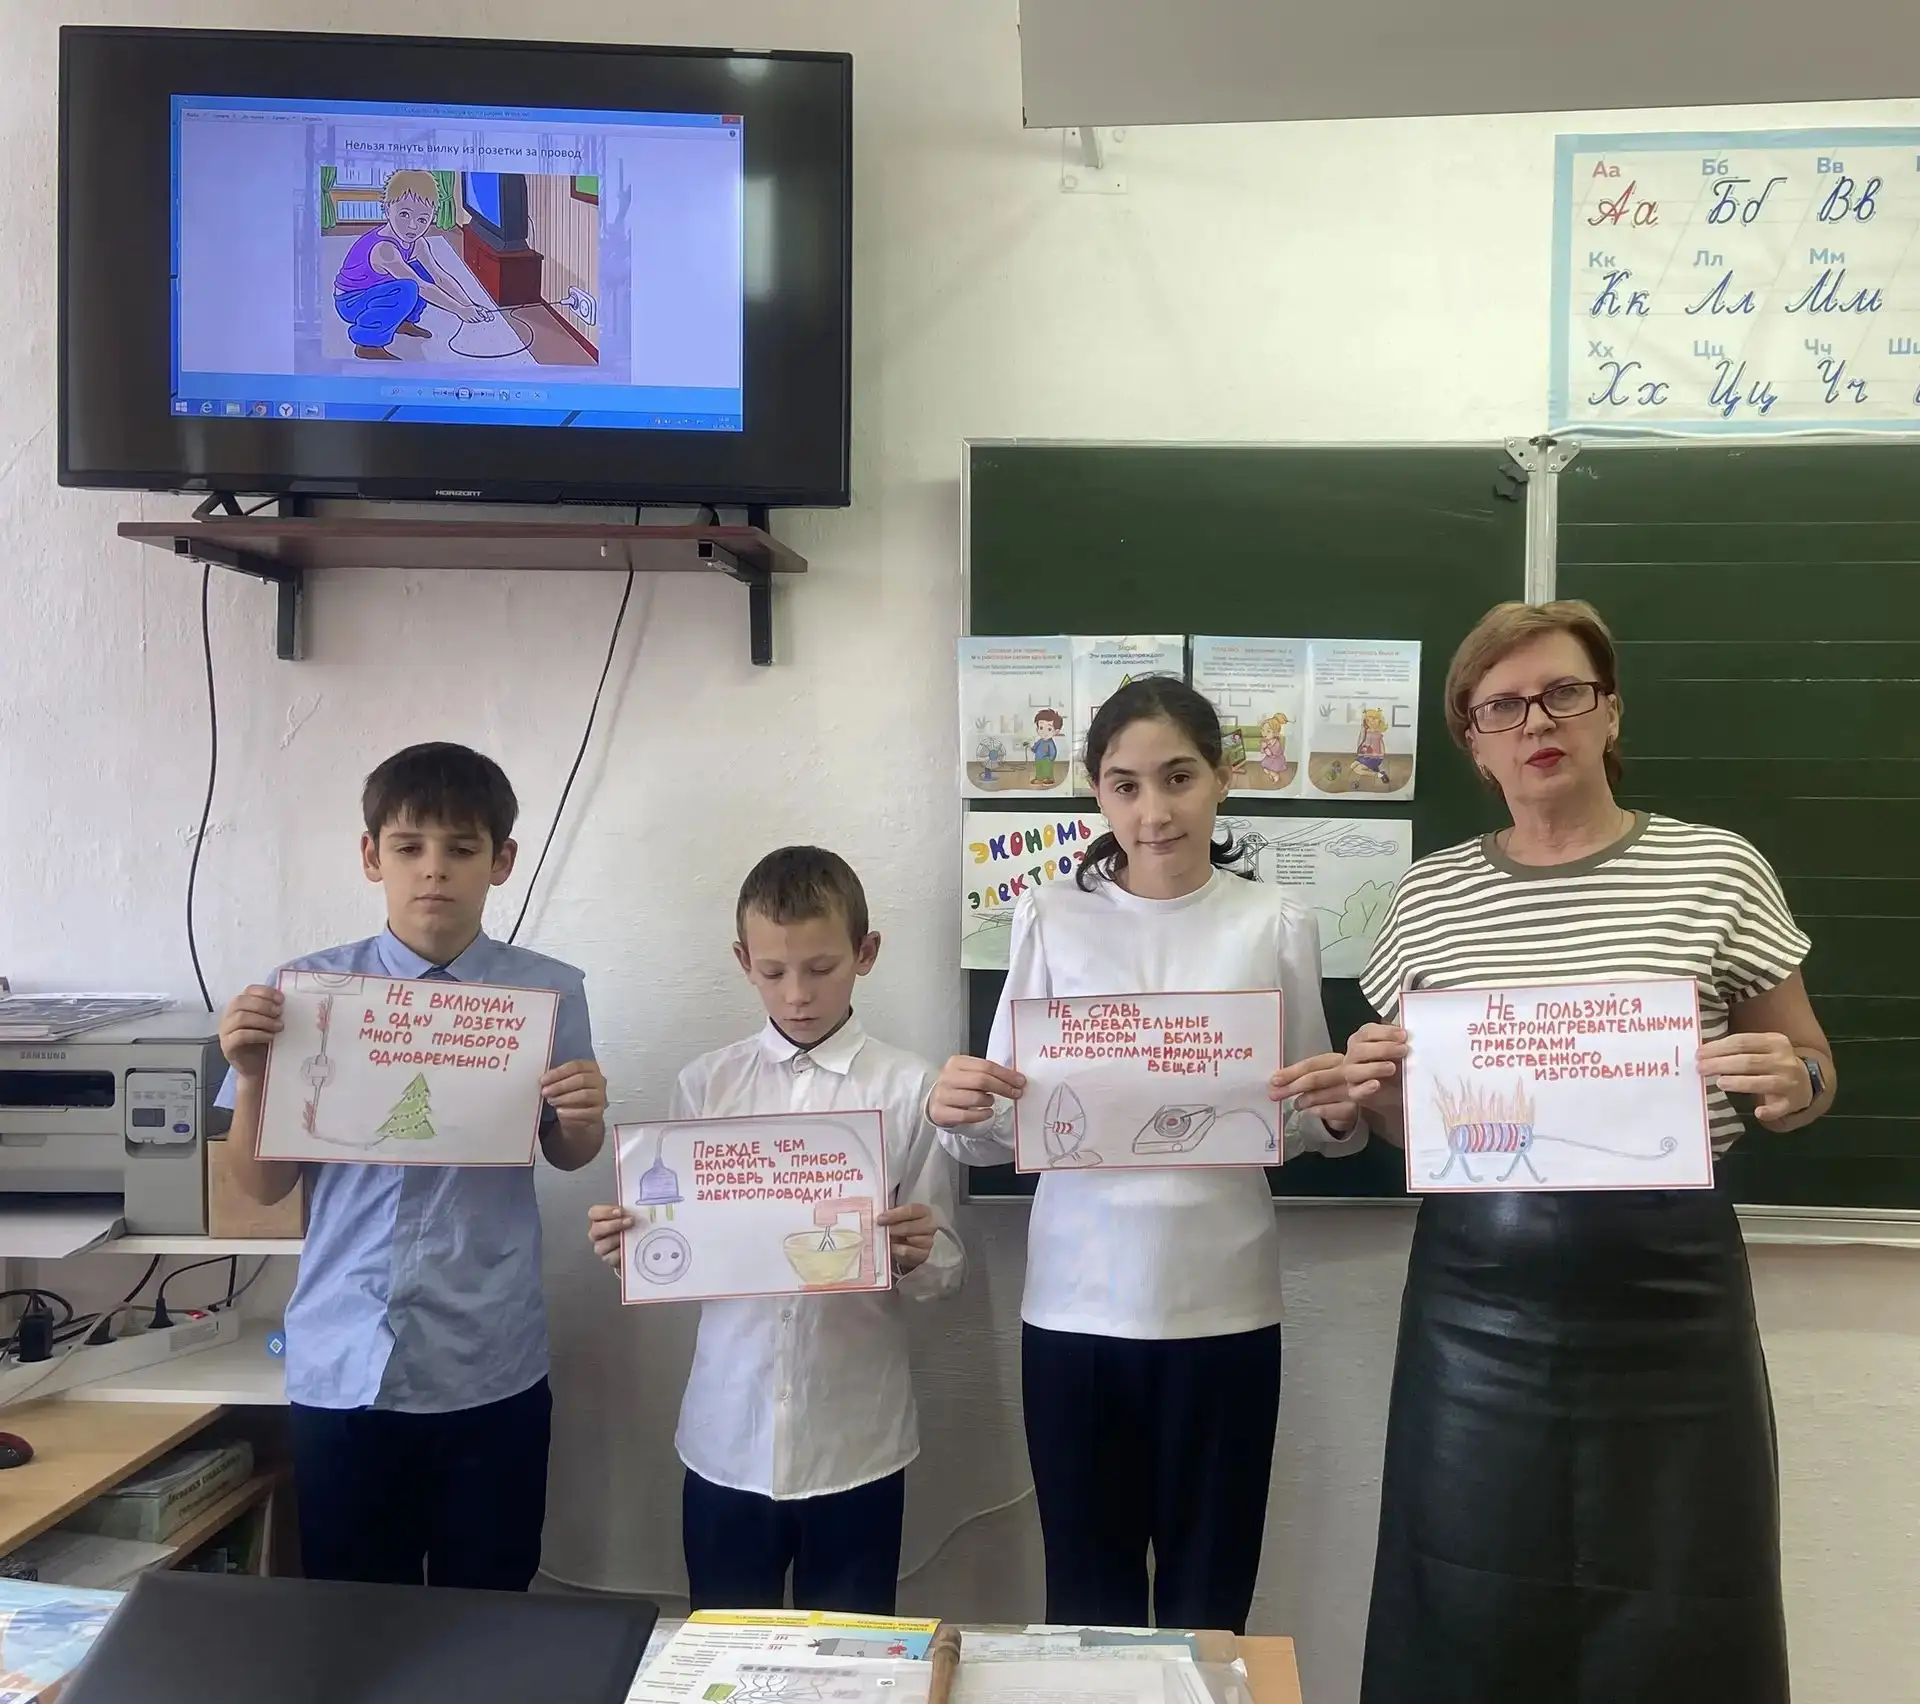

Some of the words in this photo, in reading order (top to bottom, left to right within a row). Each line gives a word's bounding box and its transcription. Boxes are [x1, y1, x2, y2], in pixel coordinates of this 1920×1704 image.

[345, 139, 385, 151] Нельзя
[388, 143, 424, 154] тянуть
[427, 144, 459, 156] вилку
[463, 146, 475, 154] из
[478, 146, 523, 157] розетки
[526, 148, 538, 157] за
[541, 149, 582, 160] провод
[435, 489, 482, 497] HORIZONT
[969, 819, 1091, 865] ЭКОНОМЬ
[430, 993, 515, 1014] ВКЛЮЧАЙ
[1088, 1003, 1141, 1019] СТАВЬ
[1536, 992, 1643, 1021] ПОЛЬЗУЙСЯ
[389, 1012, 433, 1030] ОДНУ
[453, 1014, 527, 1031] РОЗЕТКУ
[1061, 1015, 1210, 1031] НАГРЕВАТЕЛЬНЫЕ
[1467, 1016, 1694, 1036] ЭЛЕКТРОНАГРЕВАТЕЛЬНЫМИ
[359, 1028, 413, 1045] МНОГО
[431, 1031, 520, 1050] ПРИБОРОВ
[1062, 1031, 1137, 1045] ПРИБОРЫ
[1163, 1030, 1224, 1046] ВБЛИЗИ
[1470, 1036, 1576, 1052] ПРИБОРАМИ
[20, 1050, 67, 1060] SAMSUNG
[1471, 1050, 1603, 1070] СОБСТВЕННОГО
[774, 1139, 805, 1154] ЧЕМ
[694, 1157, 776, 1171] ВКЛЮЧИТЬ
[695, 1172, 764, 1186] ПРОВЕРЬ
[773, 1169, 864, 1185] ИСПРАВНОСТЬ
